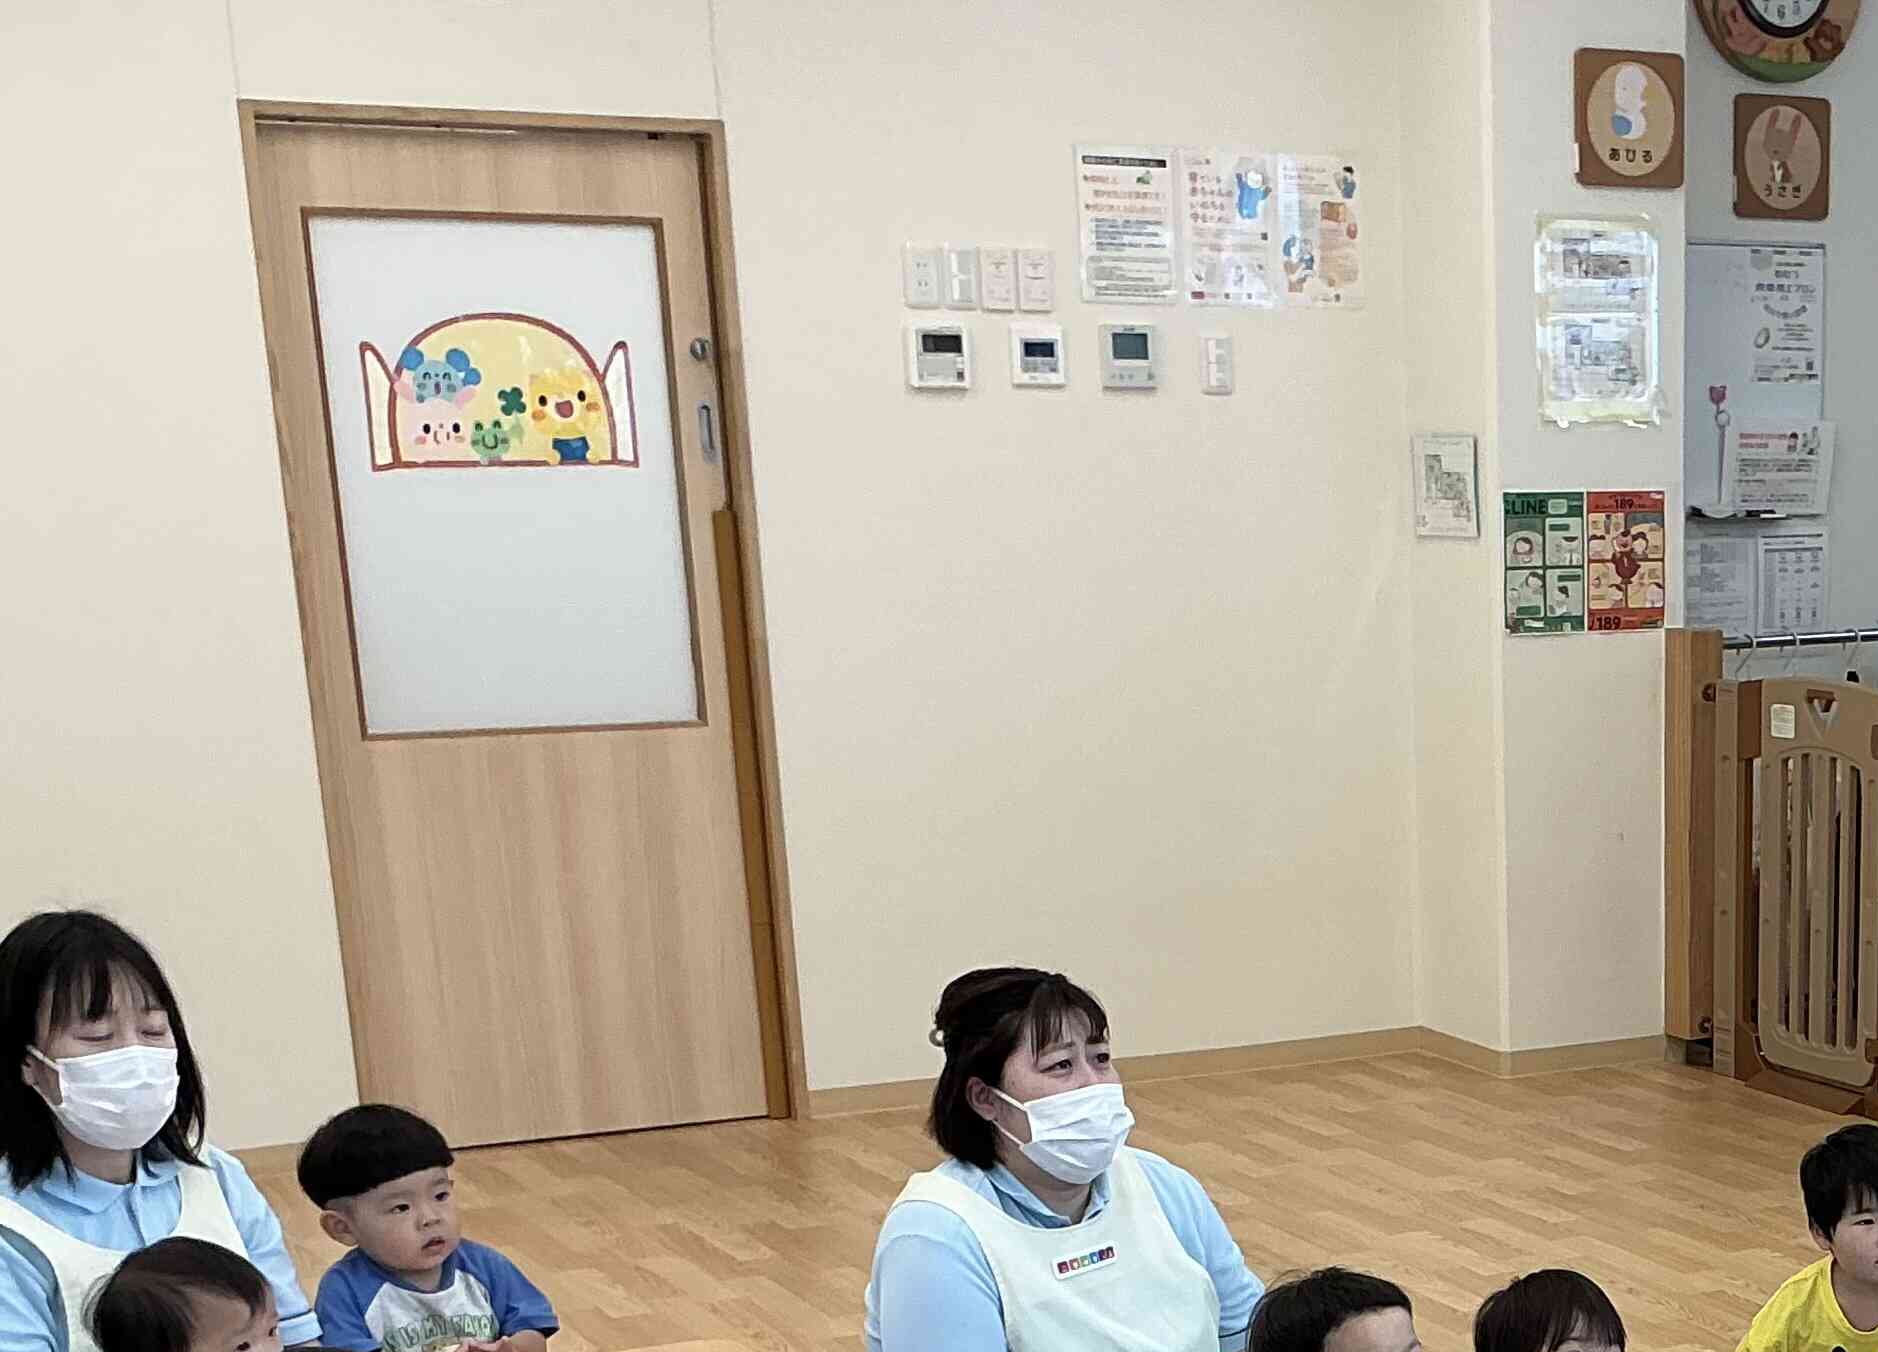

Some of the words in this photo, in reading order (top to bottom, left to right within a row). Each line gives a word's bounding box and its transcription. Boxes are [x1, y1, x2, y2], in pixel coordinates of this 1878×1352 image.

[1608, 147, 1653, 163] あひる
[1763, 184, 1802, 199] うさぎ
[1614, 498, 1634, 510] 189
[1596, 616, 1621, 630] 189
